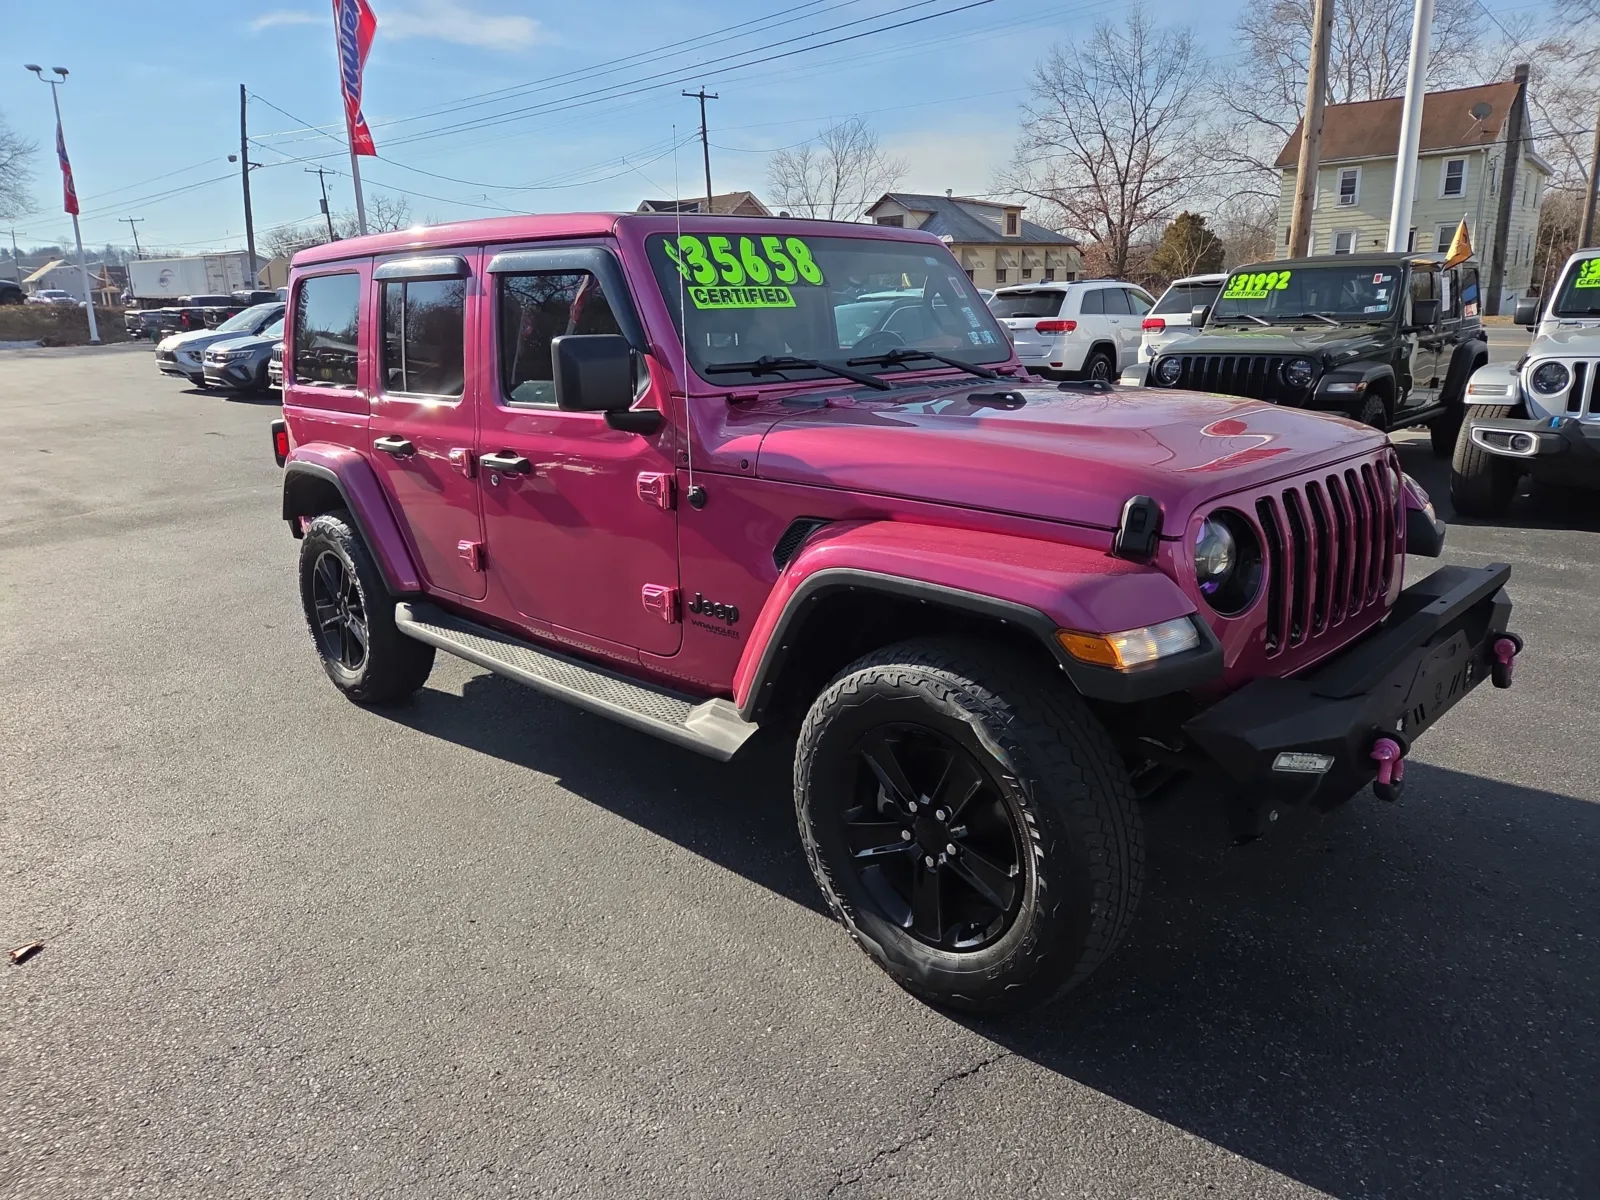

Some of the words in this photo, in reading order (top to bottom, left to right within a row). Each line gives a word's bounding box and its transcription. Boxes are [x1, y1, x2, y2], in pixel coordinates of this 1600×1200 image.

[663, 236, 824, 286] $35658
[1228, 270, 1291, 291] $31992
[693, 288, 790, 305] CERTIFIED
[688, 592, 739, 626] Jeep
[691, 619, 739, 637] WRANGLER
